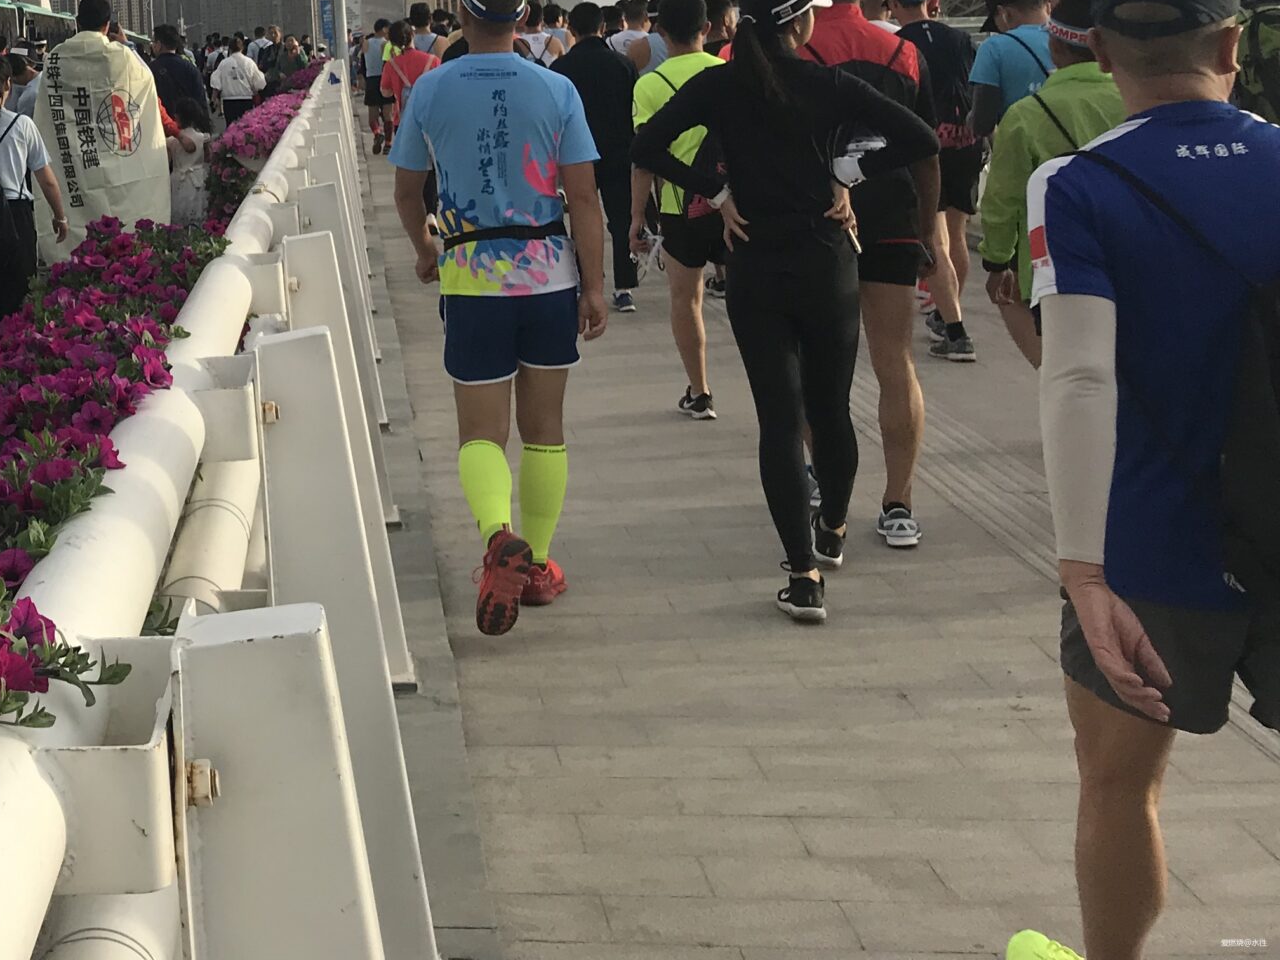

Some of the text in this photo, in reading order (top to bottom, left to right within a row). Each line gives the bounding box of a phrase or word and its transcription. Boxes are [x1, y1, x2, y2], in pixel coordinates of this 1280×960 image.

[46, 52, 84, 208] 中铁十四局集团有限公司
[72, 86, 100, 169] 中国铁建
